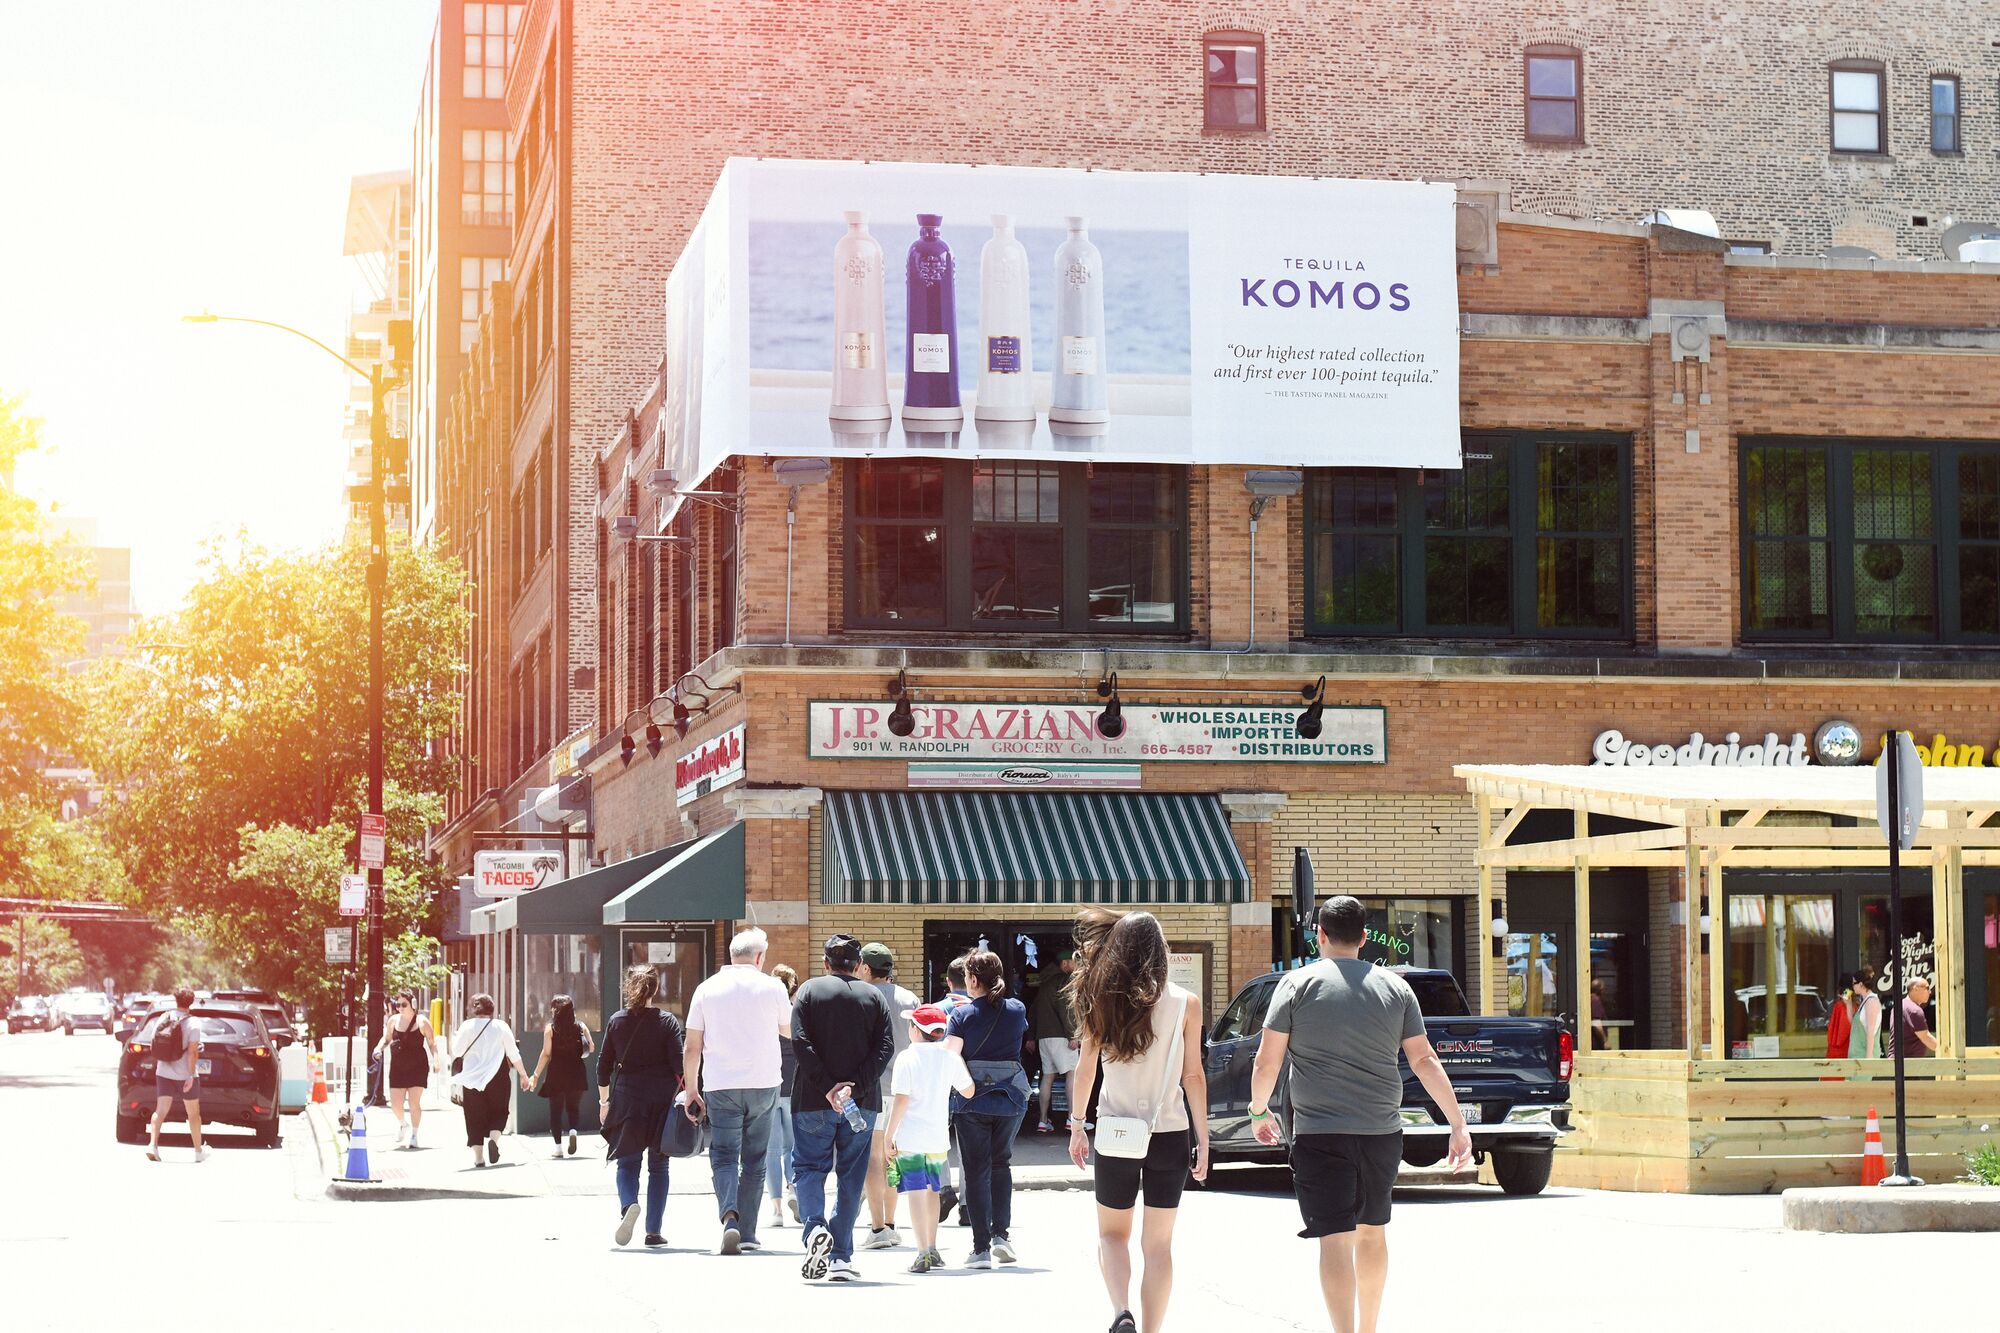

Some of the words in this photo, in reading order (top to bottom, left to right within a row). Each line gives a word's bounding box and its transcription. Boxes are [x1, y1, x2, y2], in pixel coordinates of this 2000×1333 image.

[1283, 258, 1366, 272] TEQUILA
[1240, 278, 1411, 312] KOMOS
[1266, 345, 1315, 363] highest
[1319, 346, 1356, 361] rated
[1359, 347, 1425, 363] collection
[1213, 366, 1242, 379] and
[1243, 364, 1273, 383] first
[1277, 369, 1307, 380] ever
[1311, 367, 1377, 385] 100-point
[1324, 391, 1347, 399] PANEL
[1159, 711, 1296, 725] WHOLESALERS
[823, 707, 880, 750] J.P.
[852, 741, 873, 752] 901
[879, 742, 893, 752] W.
[899, 742, 970, 753] RANDOLPH
[991, 742, 1063, 754] GROCERY
[1102, 743, 1127, 755] Inc.
[1140, 744, 1213, 755] 666-4587
[1239, 743, 1374, 756] DISTRIBUTORS
[1592, 729, 1810, 767] Goodnight
[1000, 769, 1050, 779] Fiorucci
[482, 871, 535, 886] TACOS
[1900, 931, 1921, 947] ood
[1436, 1040, 1494, 1053] GMC
[1113, 1129, 1127, 1139] TF
